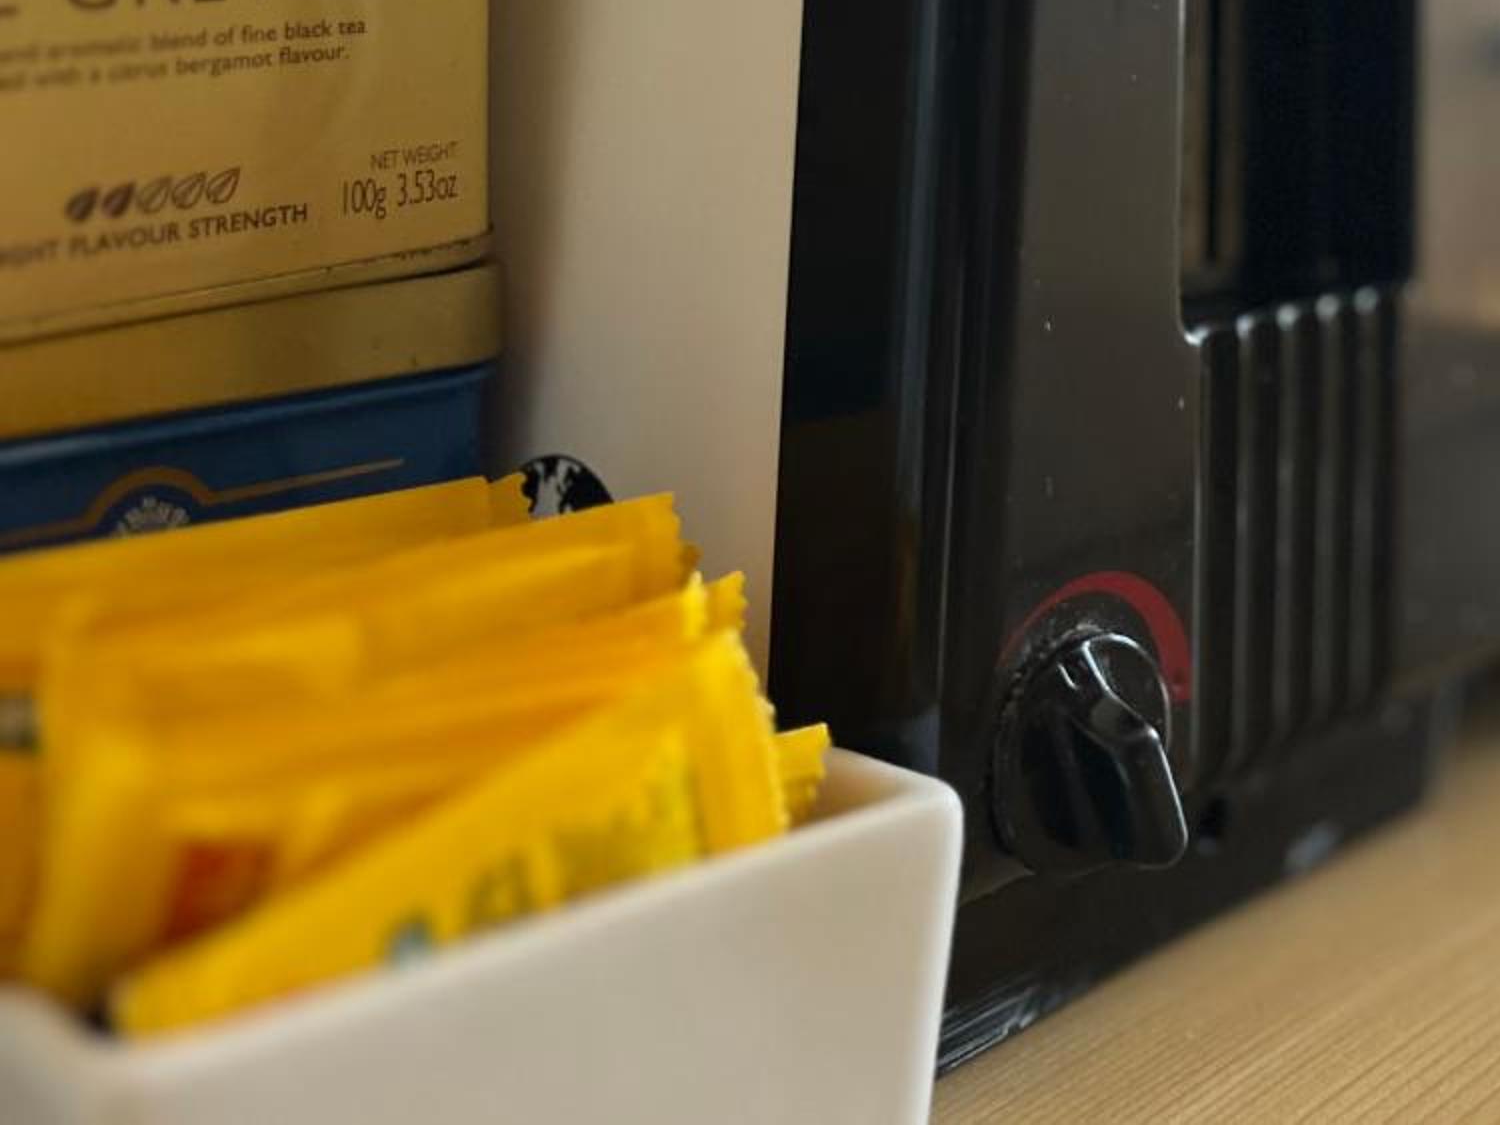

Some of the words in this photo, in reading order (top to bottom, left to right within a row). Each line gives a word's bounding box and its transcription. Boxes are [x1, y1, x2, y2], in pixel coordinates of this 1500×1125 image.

[150, 27, 207, 51] blend
[212, 25, 235, 46] of
[240, 24, 277, 43] fine
[284, 19, 333, 41] black
[338, 19, 367, 36] tea
[175, 51, 273, 77] bergamot
[278, 45, 351, 66] flavour.
[370, 149, 400, 170] NET
[401, 139, 458, 166] WEIGHT
[342, 177, 386, 220] 100g
[397, 168, 459, 208] 3.53oz
[68, 221, 180, 257] FLAVOUR
[188, 202, 308, 239] STRENGTH
